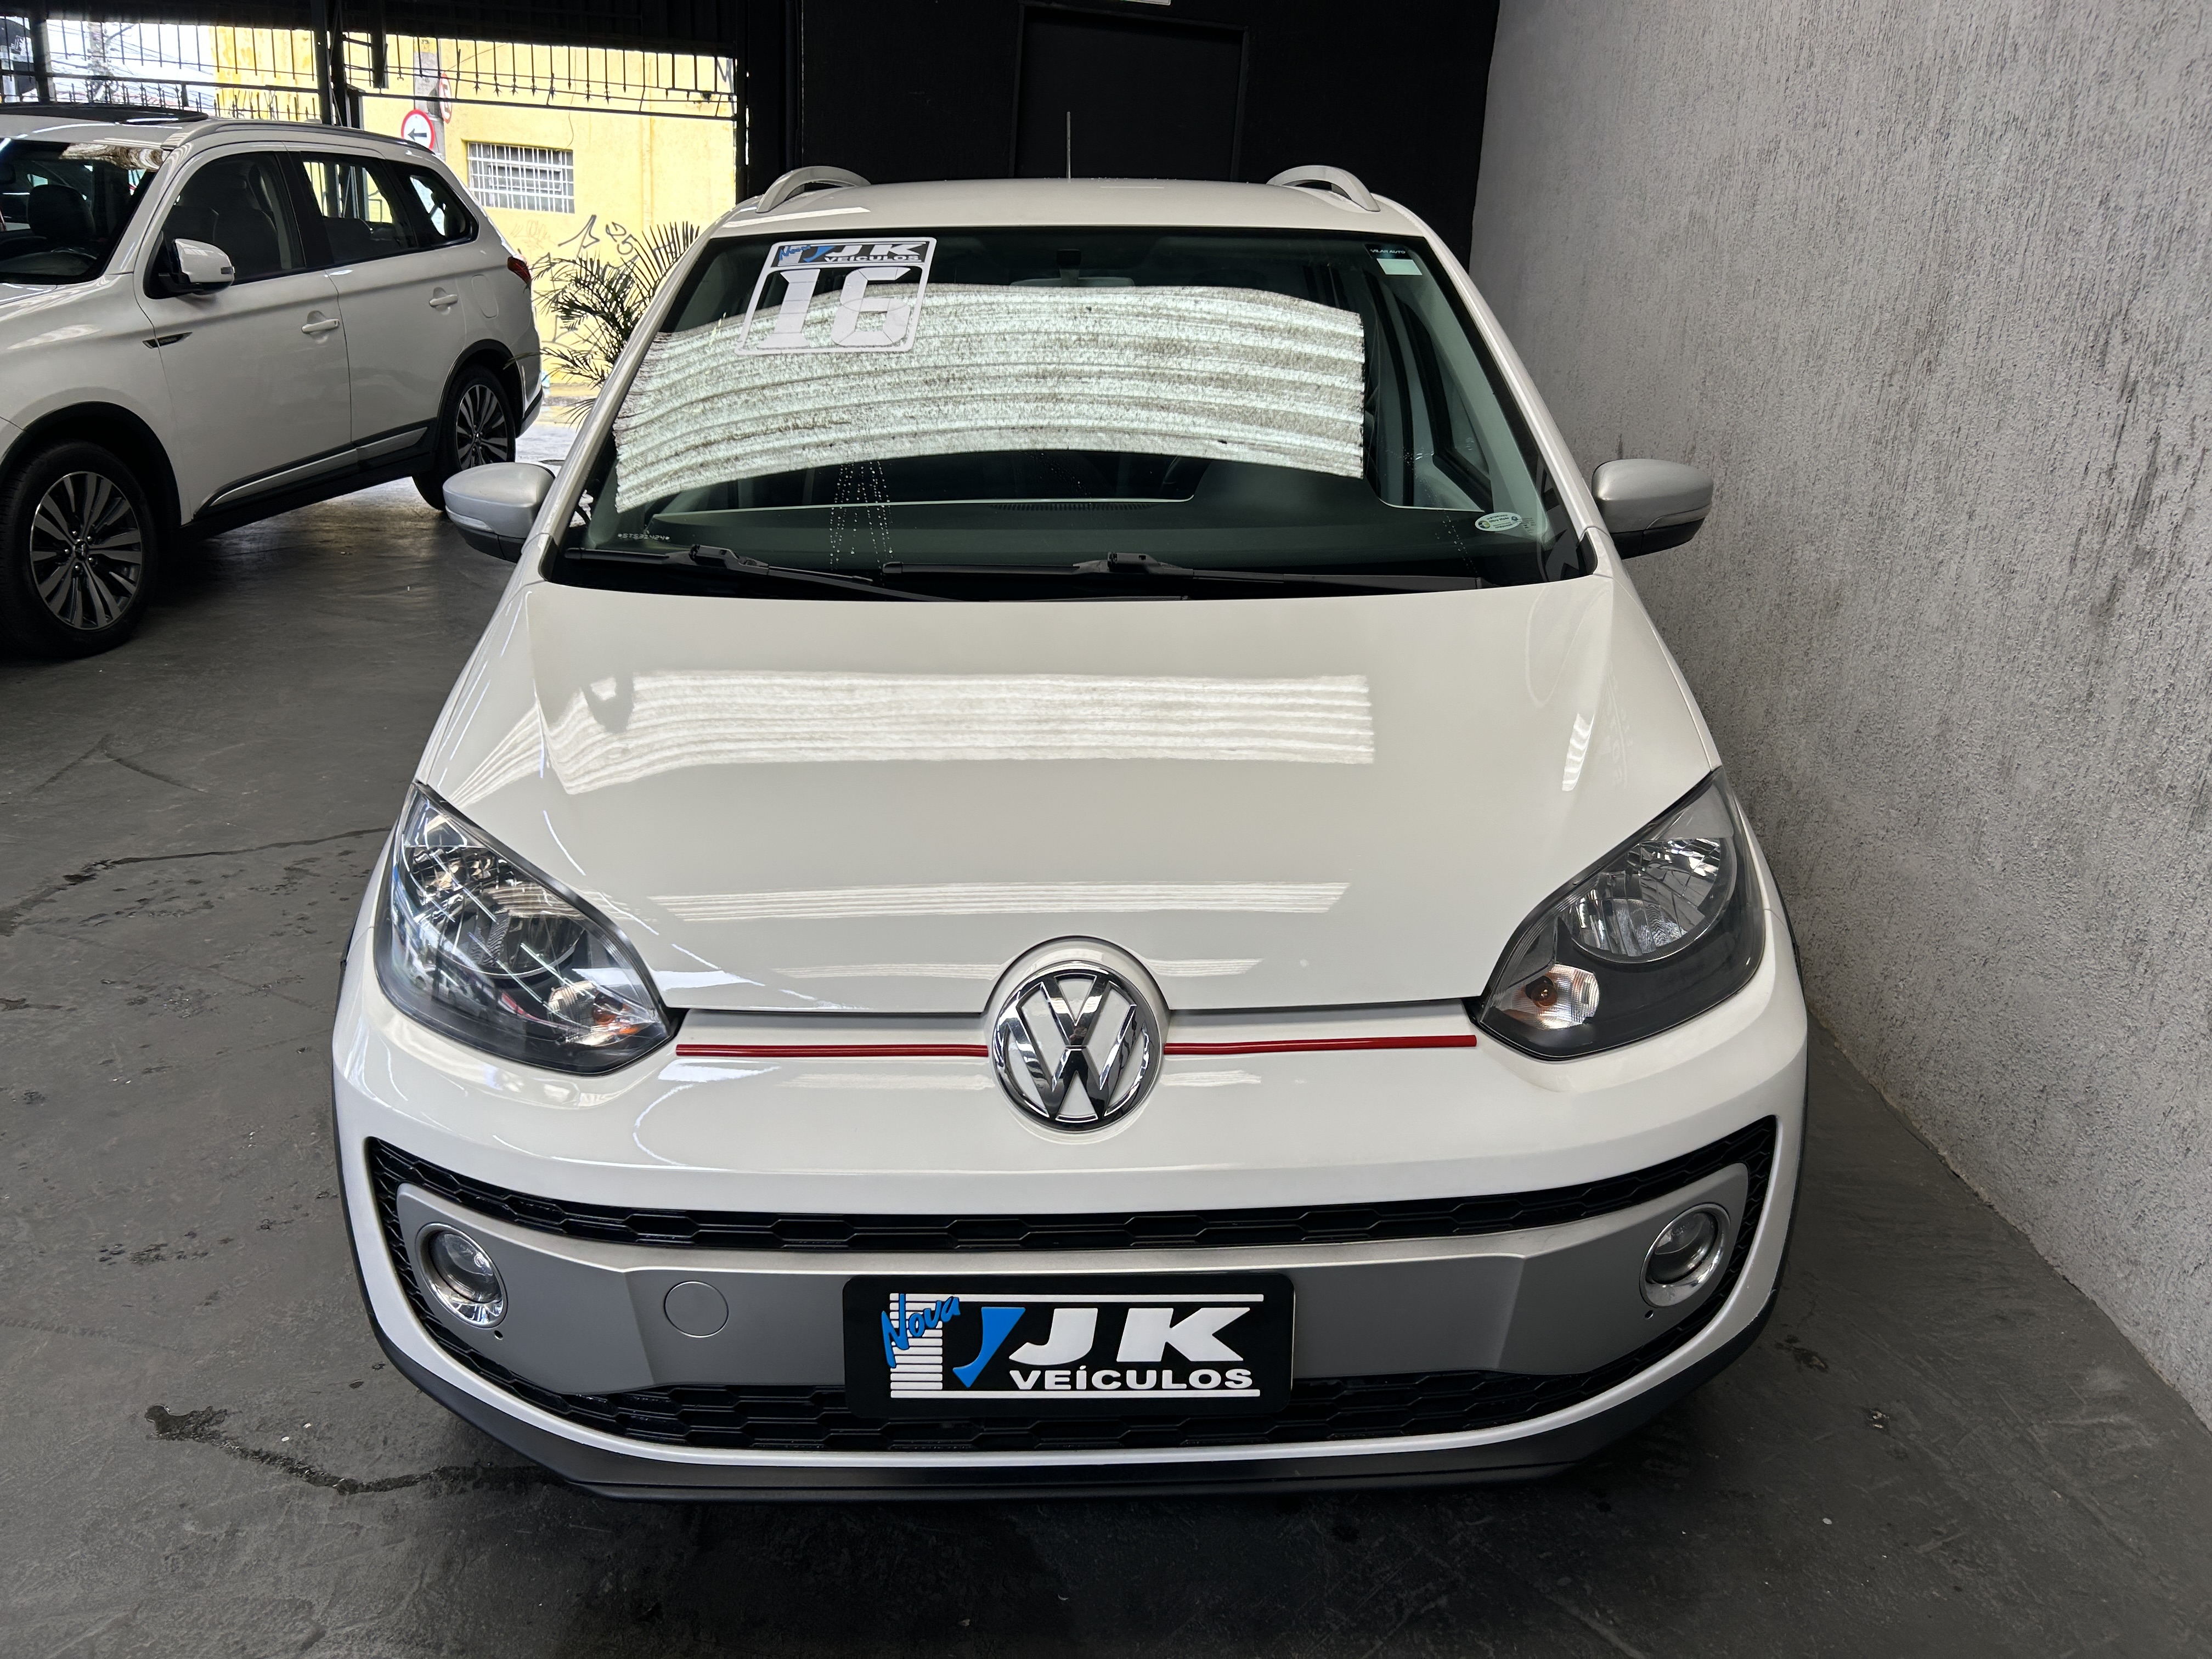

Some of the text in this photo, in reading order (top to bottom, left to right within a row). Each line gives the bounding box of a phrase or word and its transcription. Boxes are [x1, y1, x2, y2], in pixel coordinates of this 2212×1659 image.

[825, 244, 923, 257] JK
[757, 267, 911, 349] 16
[881, 1293, 961, 1368] Nova
[1009, 1307, 1250, 1365] JK
[1009, 1365, 1253, 1390] VEÍCULOS
